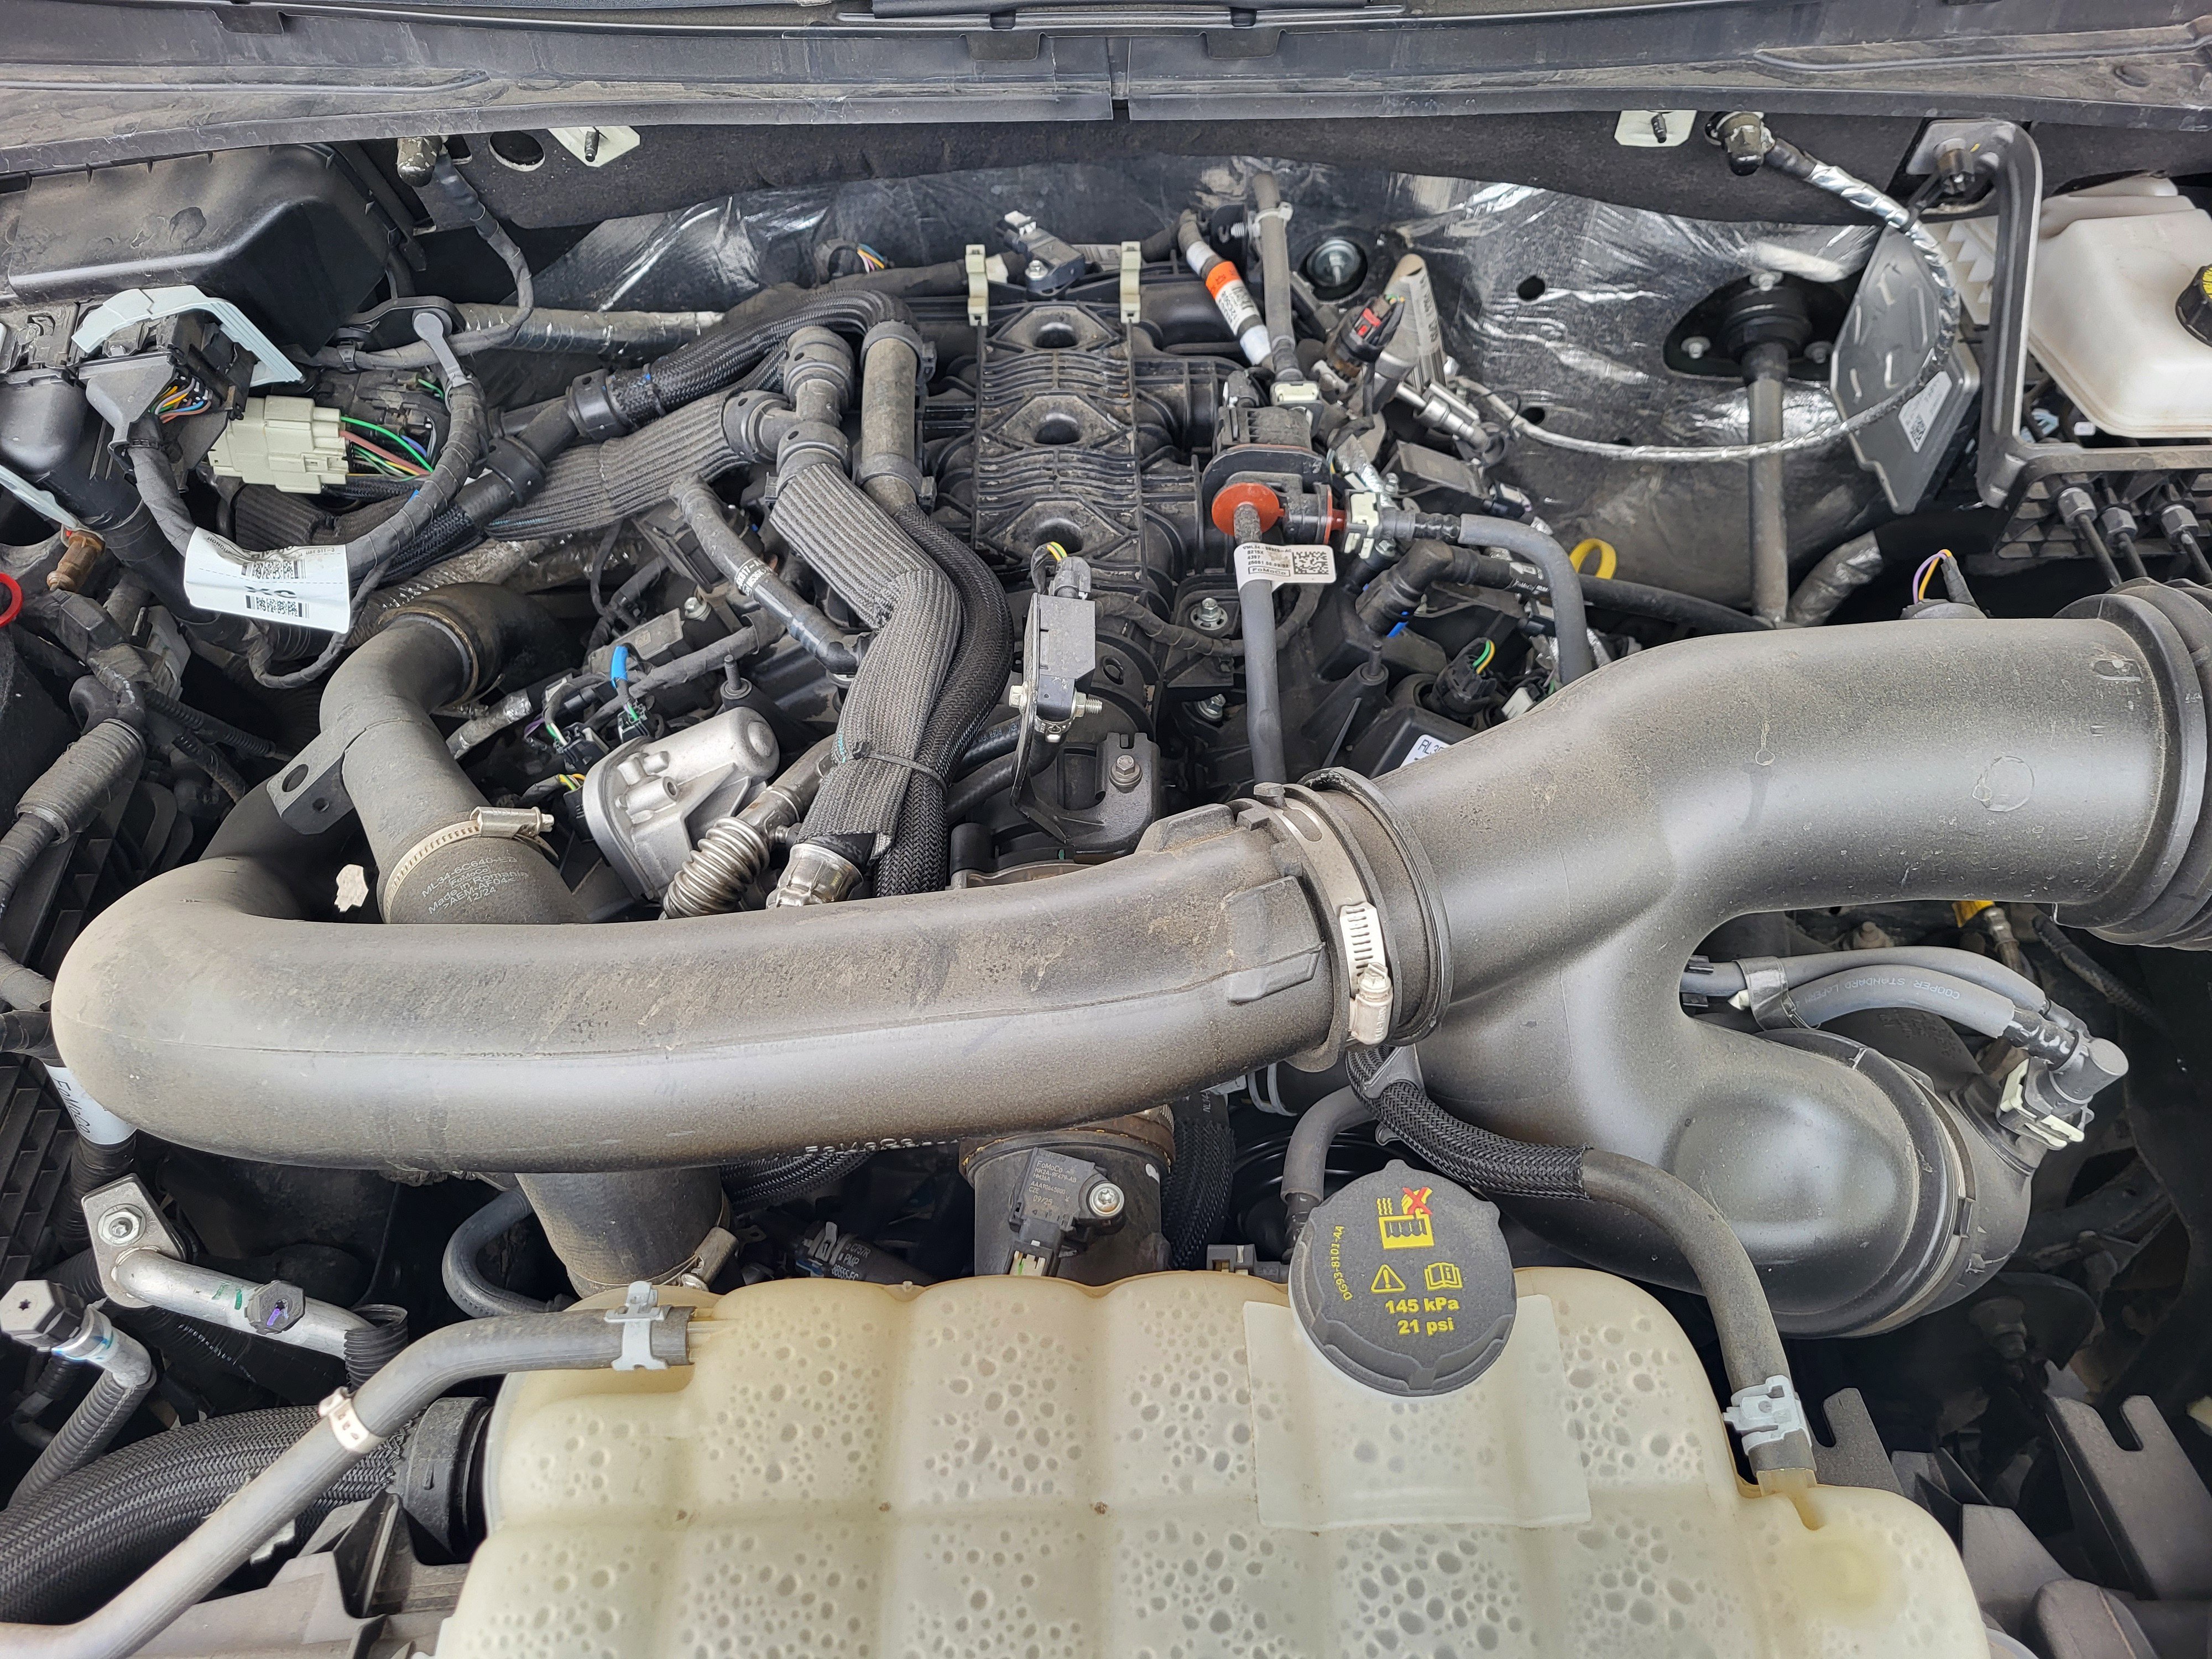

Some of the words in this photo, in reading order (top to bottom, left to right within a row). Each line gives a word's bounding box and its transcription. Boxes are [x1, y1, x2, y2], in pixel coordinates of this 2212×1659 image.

[1252, 567, 1286, 576] FoMoCo
[450, 867, 489, 887] FoMoCo
[428, 888, 458, 915] Made
[460, 880, 471, 891] in
[472, 872, 529, 885] Romania
[467, 886, 497, 902] 12/24
[1845, 977, 1906, 990] STANDARD
[1913, 979, 1960, 1000] COOPER
[57, 1079, 91, 1134] FoMoCo
[1037, 1160, 1063, 1173] FoMoCo
[1330, 1225, 1353, 1301] DG93-8101-AA
[1385, 1298, 1420, 1314] 145
[1423, 1297, 1460, 1312] kPa
[1397, 1318, 1421, 1335] 21
[1426, 1317, 1455, 1335] psi
